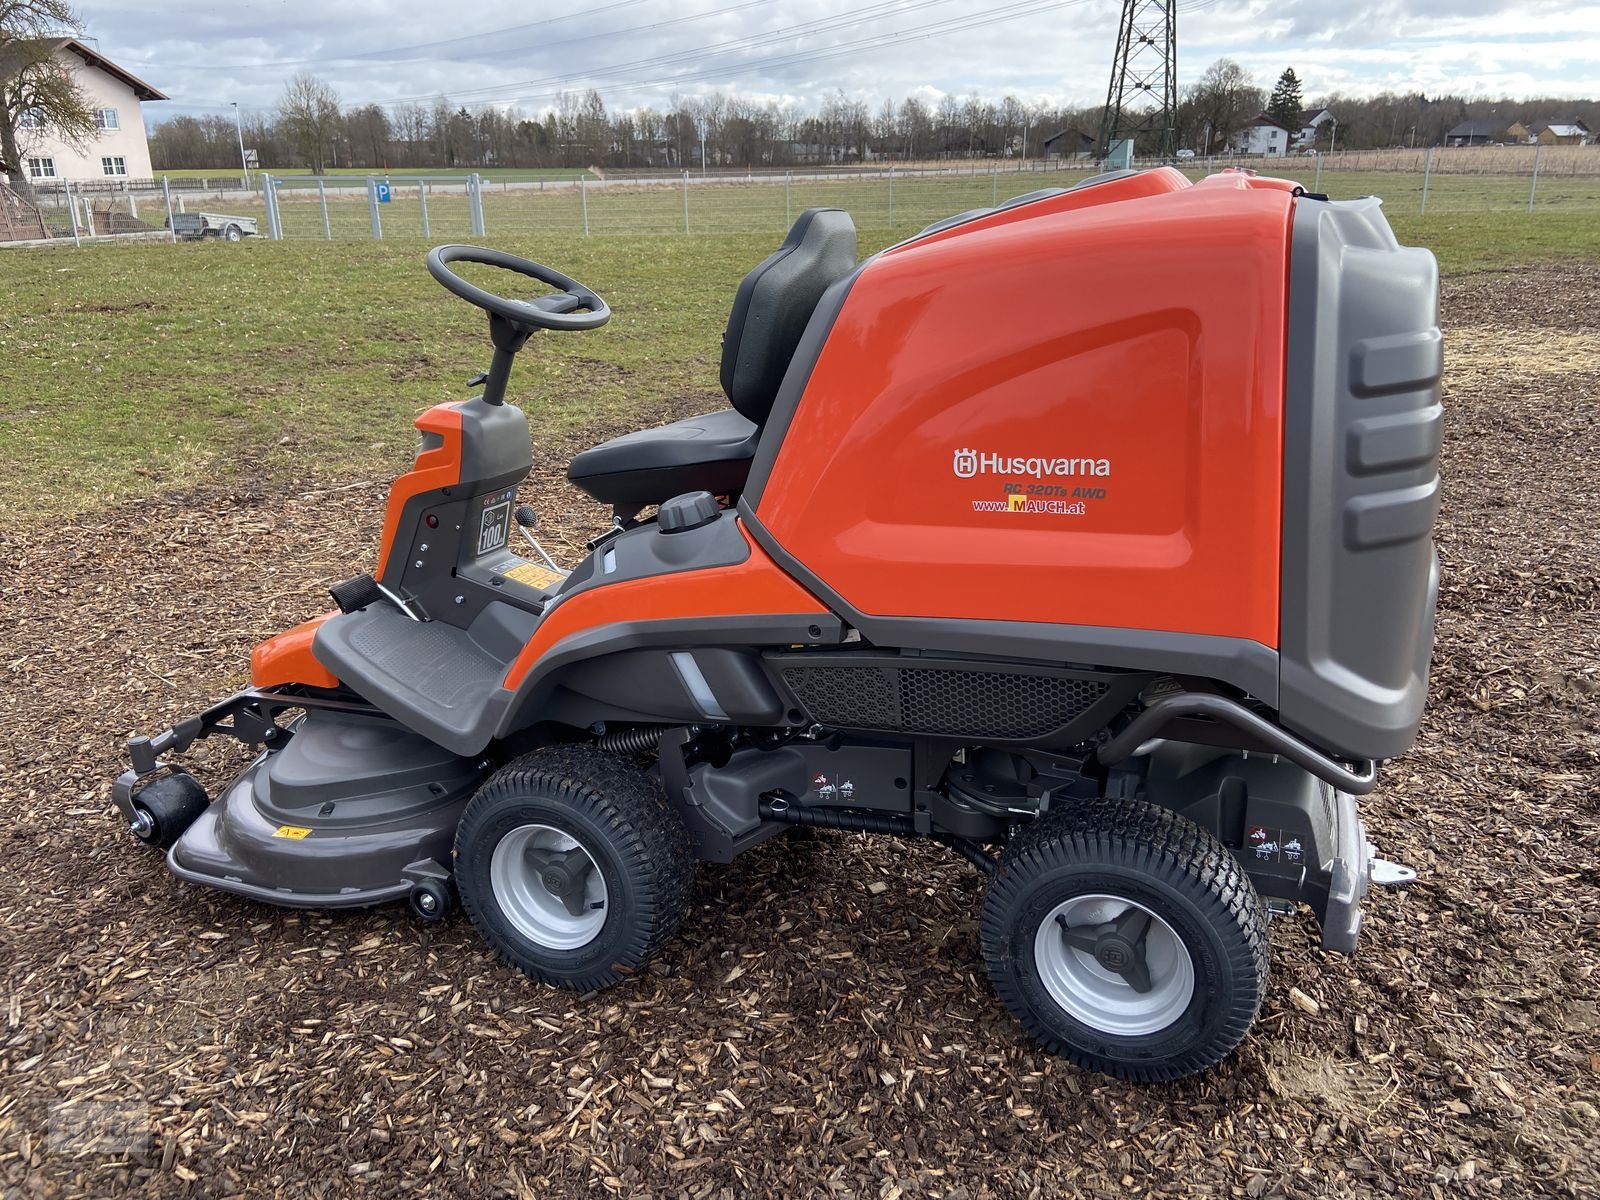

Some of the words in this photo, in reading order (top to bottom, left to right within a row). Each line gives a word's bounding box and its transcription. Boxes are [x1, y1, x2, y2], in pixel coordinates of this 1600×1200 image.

[379, 185, 388, 200] P
[980, 452, 1110, 479] Husqvarna
[1003, 483, 1023, 494] RC
[1026, 485, 1067, 497] 320Ts
[1071, 487, 1107, 499] AWD
[972, 499, 1085, 515] www.MAUCH.at
[483, 524, 501, 549] 100
